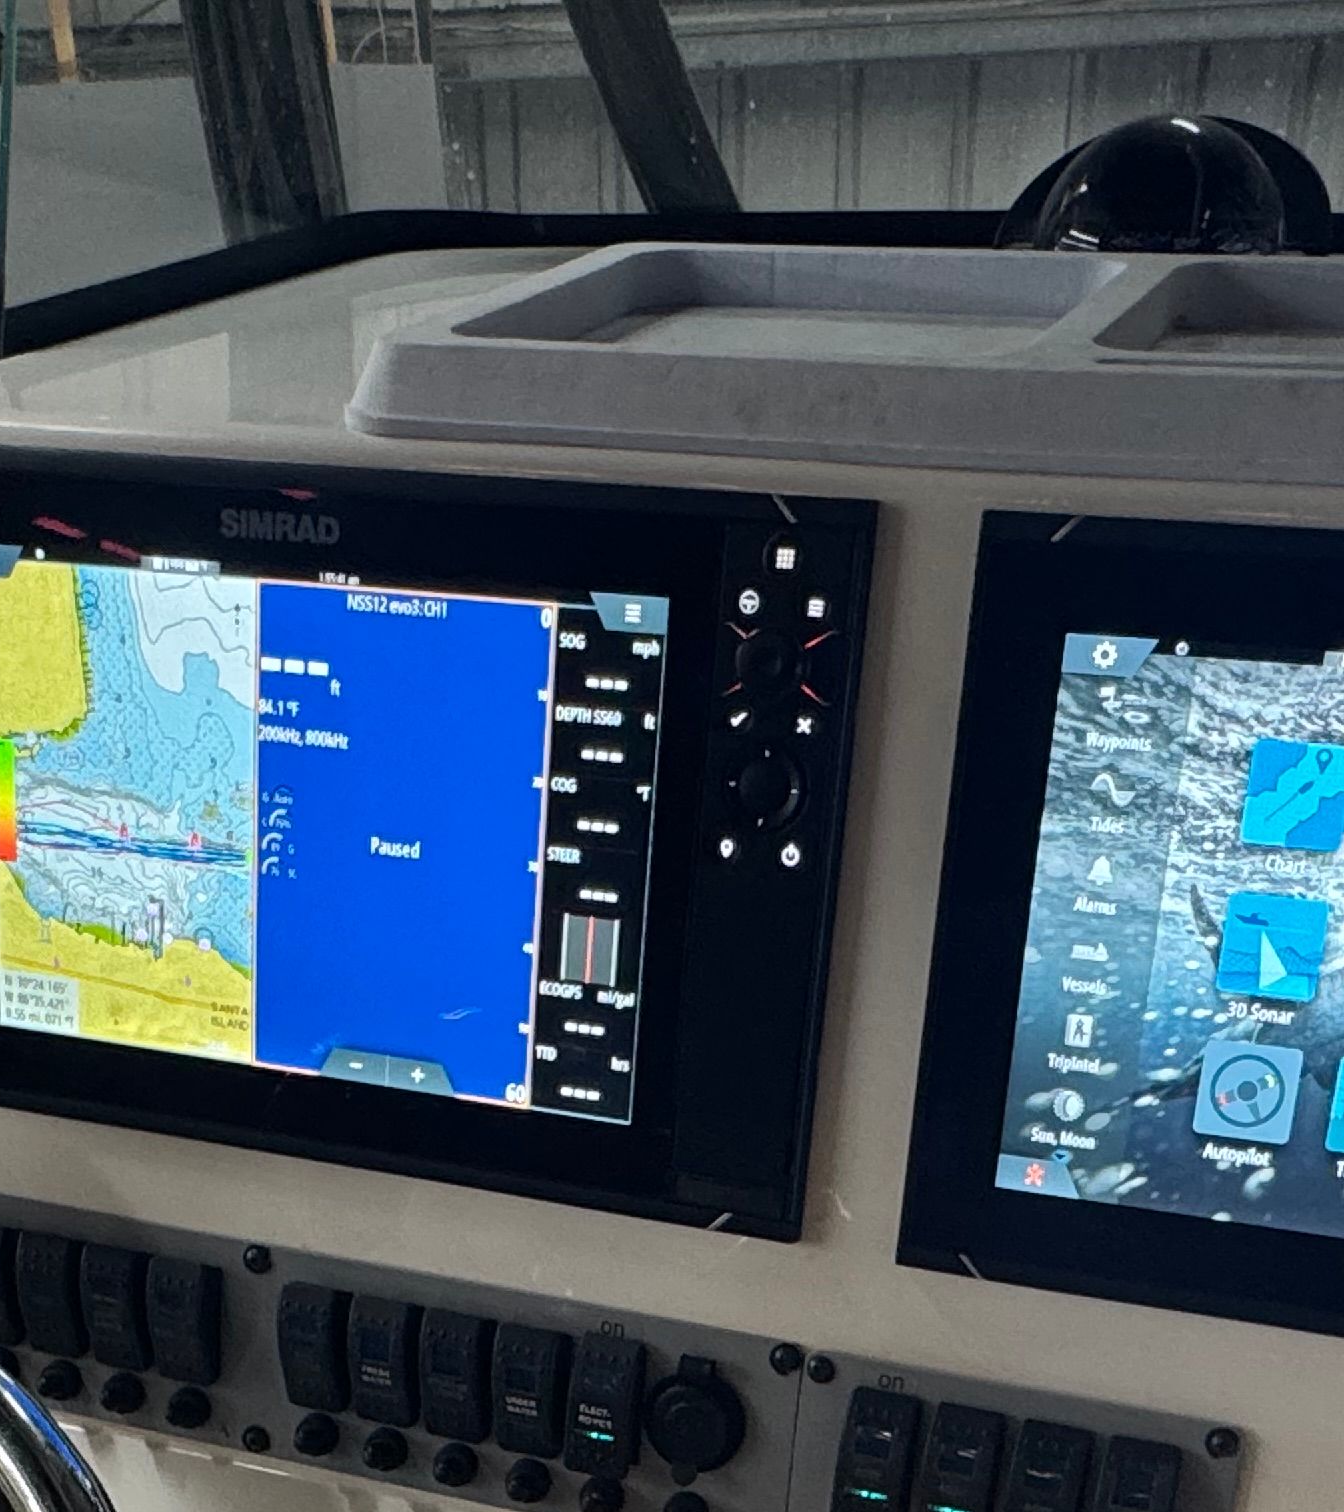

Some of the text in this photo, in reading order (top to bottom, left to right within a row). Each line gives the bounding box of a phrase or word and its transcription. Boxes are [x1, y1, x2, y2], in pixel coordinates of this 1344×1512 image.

[219, 508, 340, 545] SIMRAD
[346, 594, 448, 619] NSS12 evo3:CH1
[541, 608, 552, 628] 0
[559, 632, 586, 650] SOG
[632, 639, 660, 660] mph
[555, 704, 592, 724] DEPTH
[258, 725, 350, 750] 200kHz, 800kHz
[1086, 732, 1152, 753] Waypoints
[550, 776, 578, 794] COG
[1089, 816, 1125, 834] Tides
[370, 836, 421, 860] Paused
[546, 846, 582, 864] STEER
[1264, 854, 1310, 875] Chart
[1073, 896, 1117, 915] Alarms
[539, 980, 583, 1000] ECOGPS
[1062, 976, 1107, 995] Vessels
[210, 1001, 249, 1016] SANTA
[1226, 1001, 1295, 1026] 3D Sonar
[211, 1016, 250, 1032] ISLAND
[535, 1044, 558, 1062] TTD
[1047, 1052, 1100, 1074] TripIntel
[505, 1083, 526, 1104] 60
[1030, 1127, 1096, 1150] Sun, Moon
[1202, 1142, 1273, 1168] Autopilot
[600, 1320, 625, 1338] on
[877, 1374, 905, 1390] on
